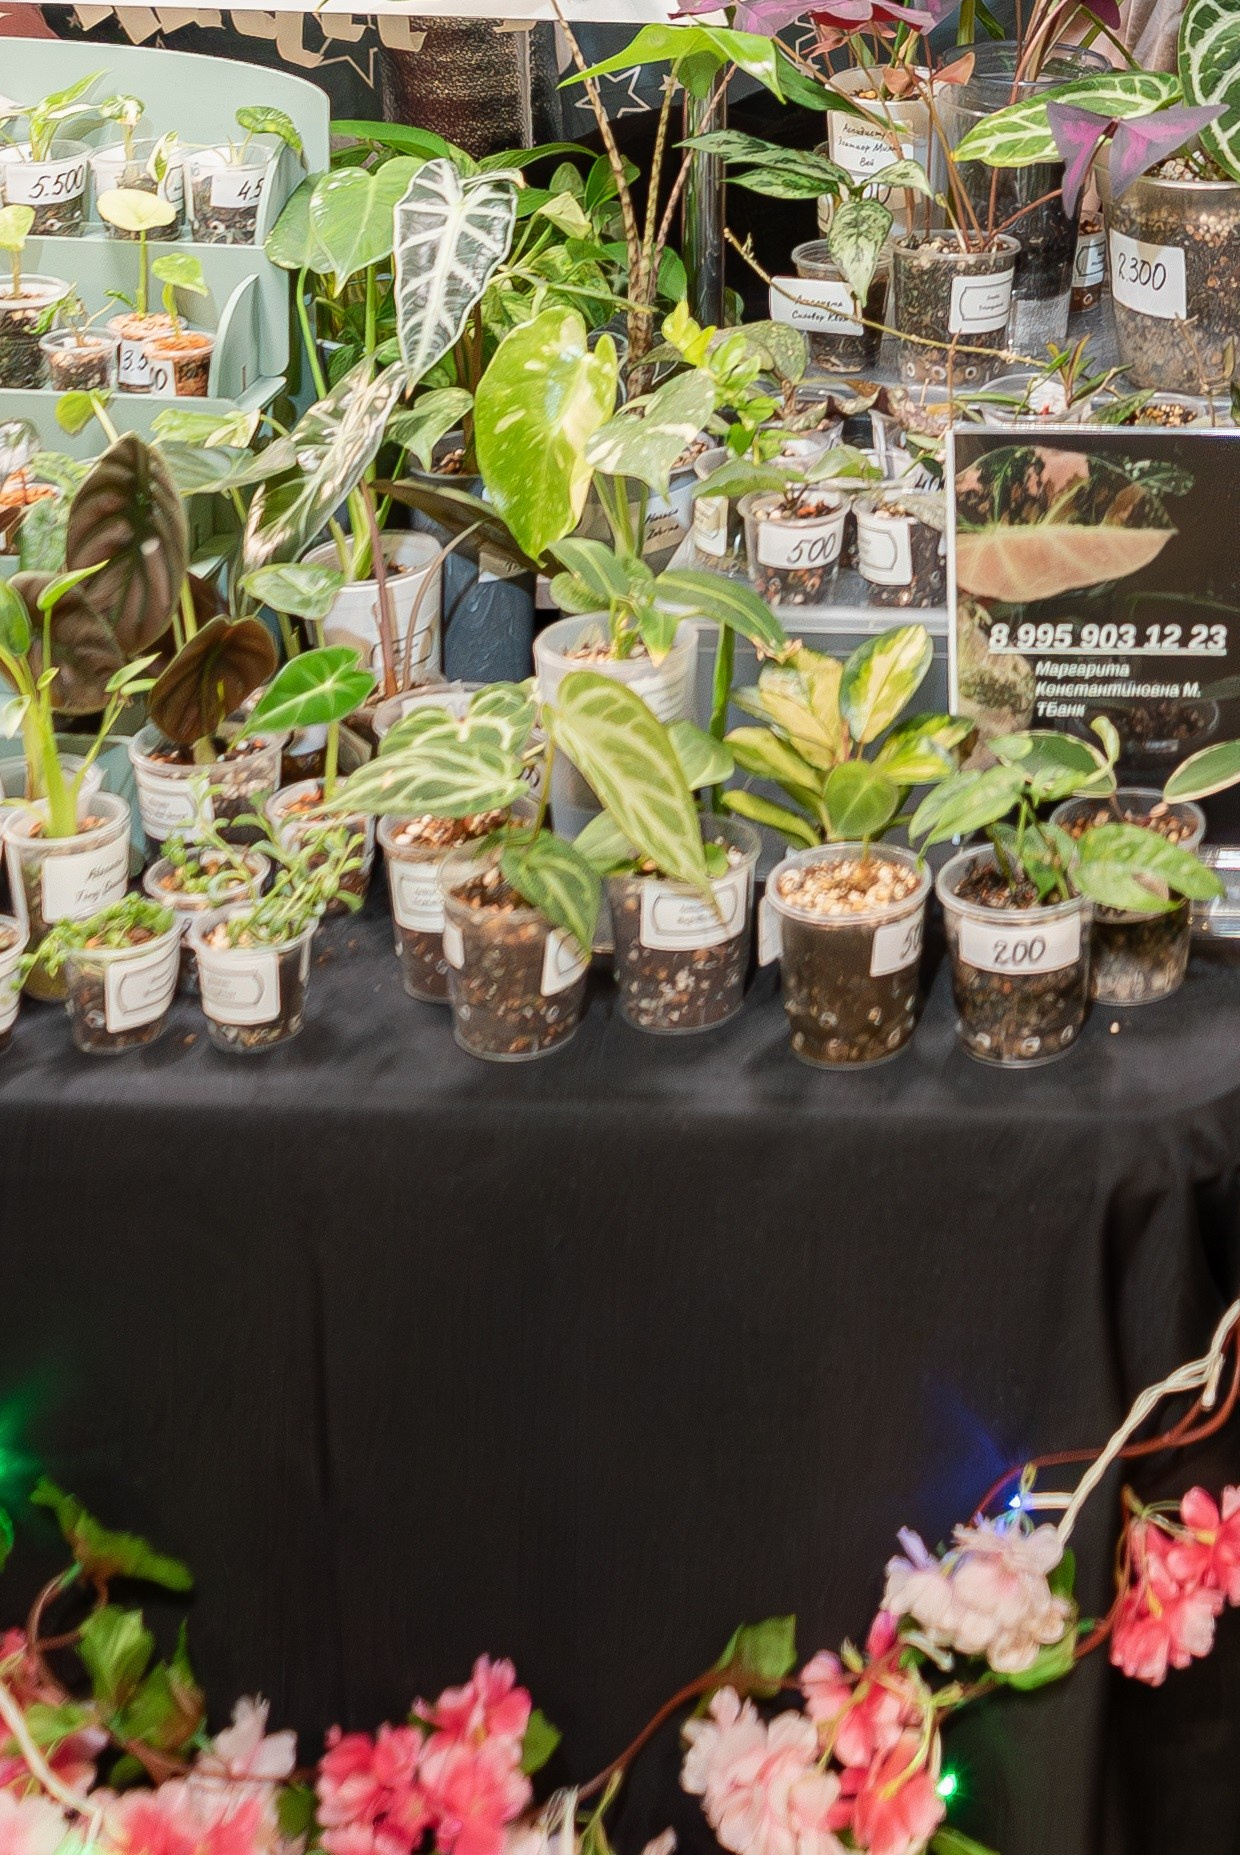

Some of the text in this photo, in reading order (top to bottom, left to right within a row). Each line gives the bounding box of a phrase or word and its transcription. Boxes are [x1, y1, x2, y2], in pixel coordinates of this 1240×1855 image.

[28, 164, 84, 199] 5.500
[1118, 252, 1166, 291] 2.300
[786, 532, 836, 564] 500
[989, 622, 1228, 651] 8 995 903 12 23
[1035, 660, 1131, 680] Маргарита
[1035, 680, 1180, 699] Константиновна
[1036, 700, 1086, 718] ТБанк
[993, 935, 1047, 966] 200
